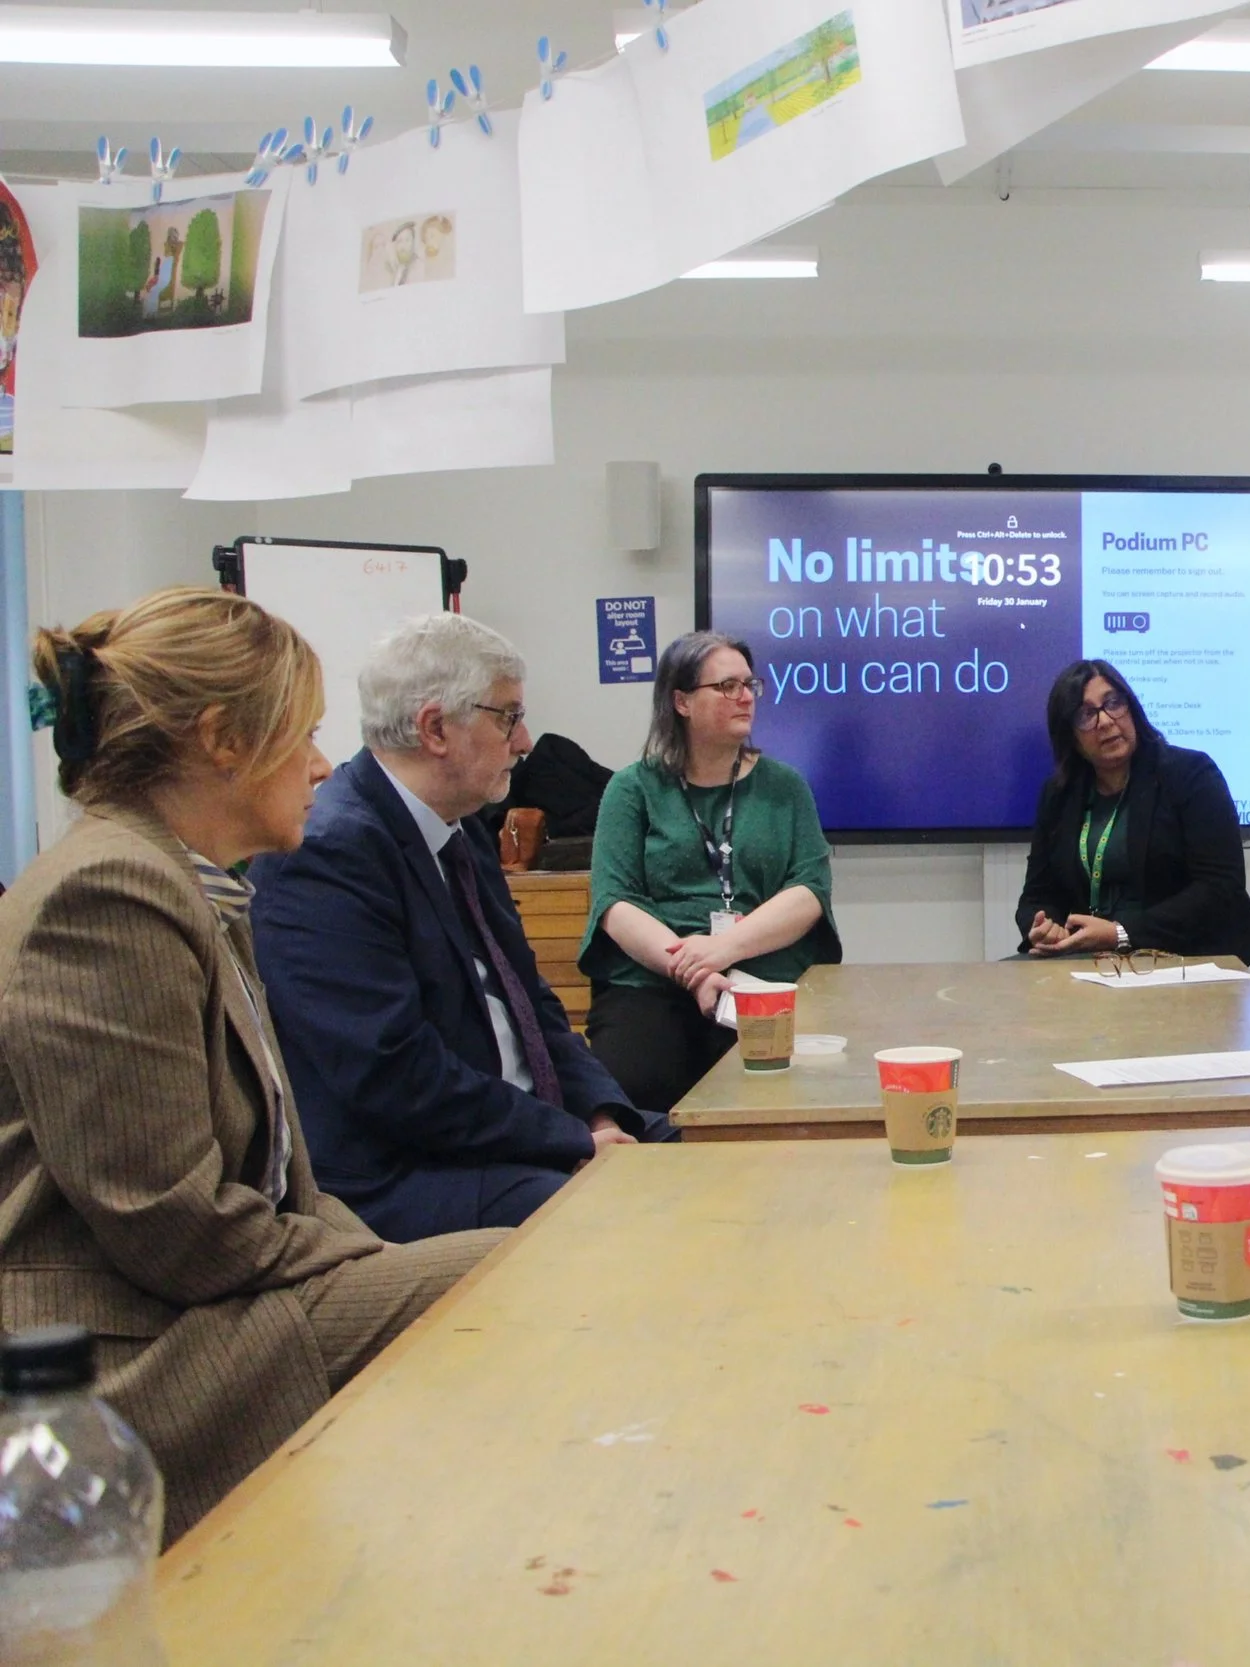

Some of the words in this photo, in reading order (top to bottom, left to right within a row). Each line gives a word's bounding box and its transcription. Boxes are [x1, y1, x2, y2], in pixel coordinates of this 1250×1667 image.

[957, 531, 976, 539] Press
[977, 531, 1032, 539] Ctrl+Alt+Delete
[1033, 531, 1041, 539] to
[1042, 531, 1067, 539] unlock.
[1102, 532, 1177, 551] Podium
[1181, 532, 1209, 552] PC
[769, 538, 833, 583] No
[847, 537, 985, 583] limits
[965, 553, 1062, 586] 10:53
[1101, 566, 1130, 575] Please
[1132, 567, 1175, 576] remember
[1178, 567, 1187, 576] to
[1188, 567, 1206, 577] sign
[605, 601, 622, 611] DO
[624, 600, 647, 610] NOT
[977, 597, 1003, 607] Friday
[1004, 598, 1015, 606] 30
[1016, 597, 1048, 607] January
[607, 612, 624, 620] alter
[626, 611, 646, 619] room
[769, 606, 822, 639] on
[835, 592, 946, 638] what
[614, 619, 638, 627] layout
[1142, 658, 1162, 666] panel
[768, 662, 847, 704] you
[861, 662, 940, 694] can
[955, 648, 1009, 694] do
[1152, 676, 1167, 684] only
